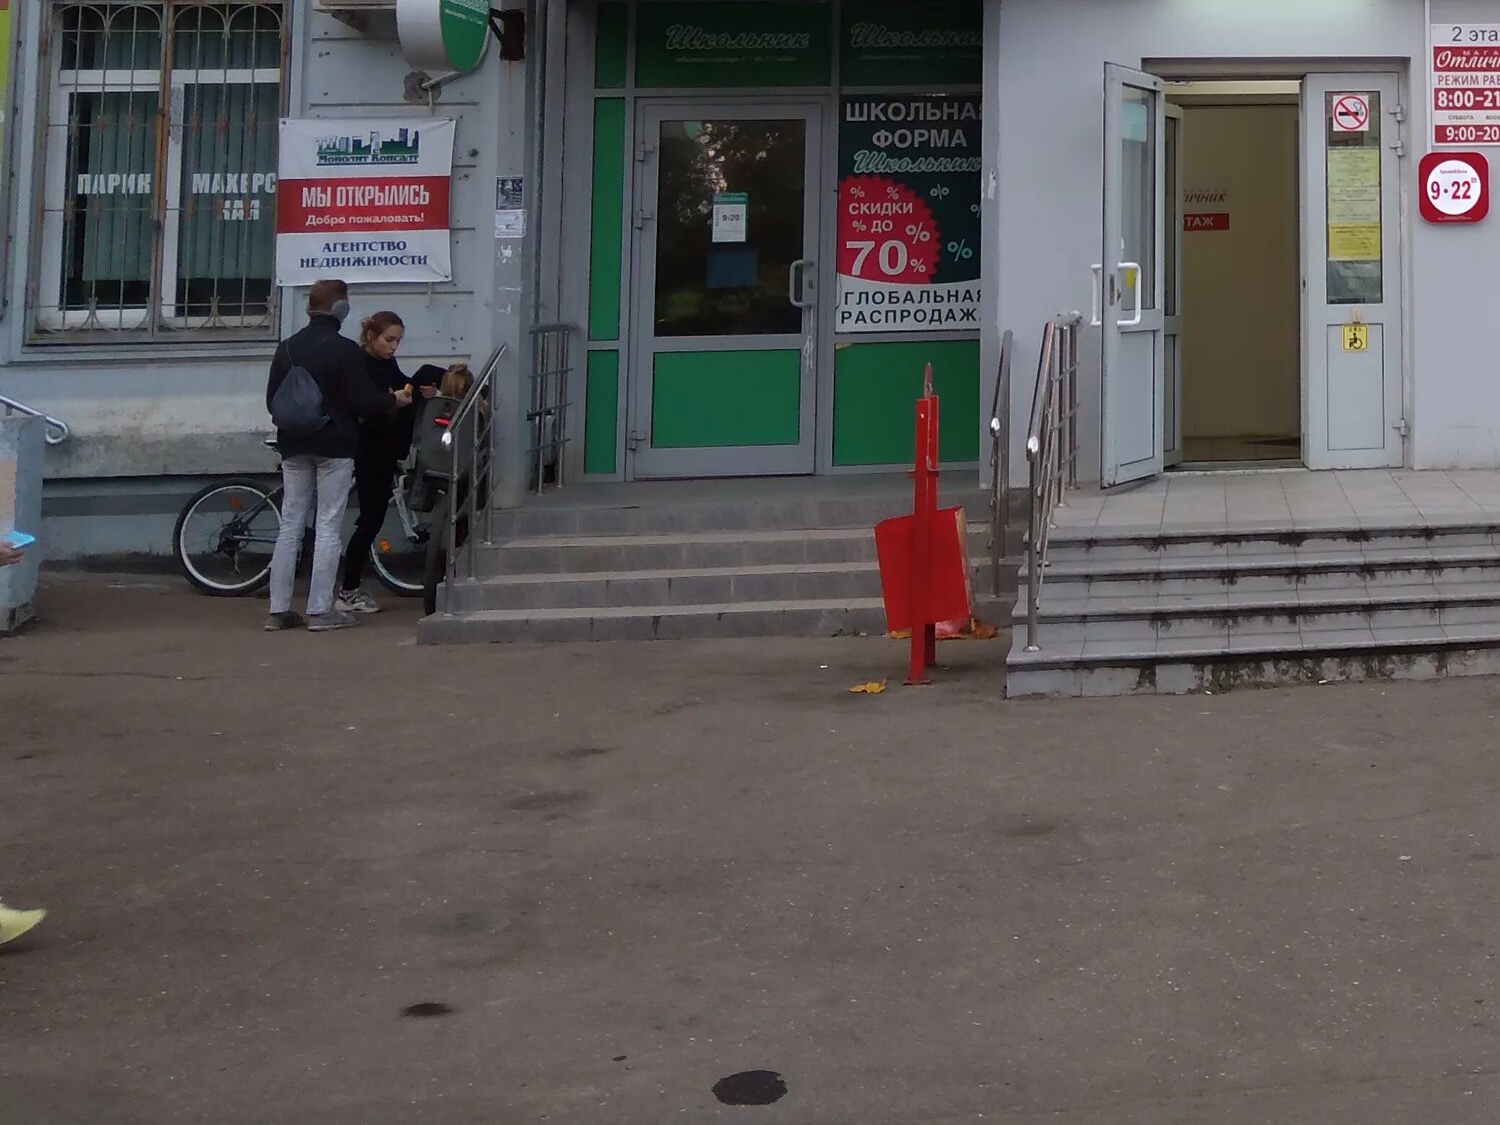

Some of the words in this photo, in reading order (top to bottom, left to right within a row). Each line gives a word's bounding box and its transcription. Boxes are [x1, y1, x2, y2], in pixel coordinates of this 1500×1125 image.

[1451, 26, 1463, 42] 2
[1437, 75, 1479, 86] РЕЖИМ
[845, 101, 983, 122] ШКОЛЬНА
[871, 129, 968, 148] ФОРМА
[853, 149, 982, 174] Школьник
[302, 186, 332, 208] МЫ
[336, 184, 430, 207] ОТКРЫЛИСЬ
[849, 202, 913, 216] СКИДКИ
[305, 214, 347, 227] Добро
[349, 212, 425, 224] пожаловать!
[870, 219, 893, 234] ДО
[321, 240, 407, 253] АГЕНТСТВО
[300, 254, 428, 269] НЕДВИЖИМОСТИ
